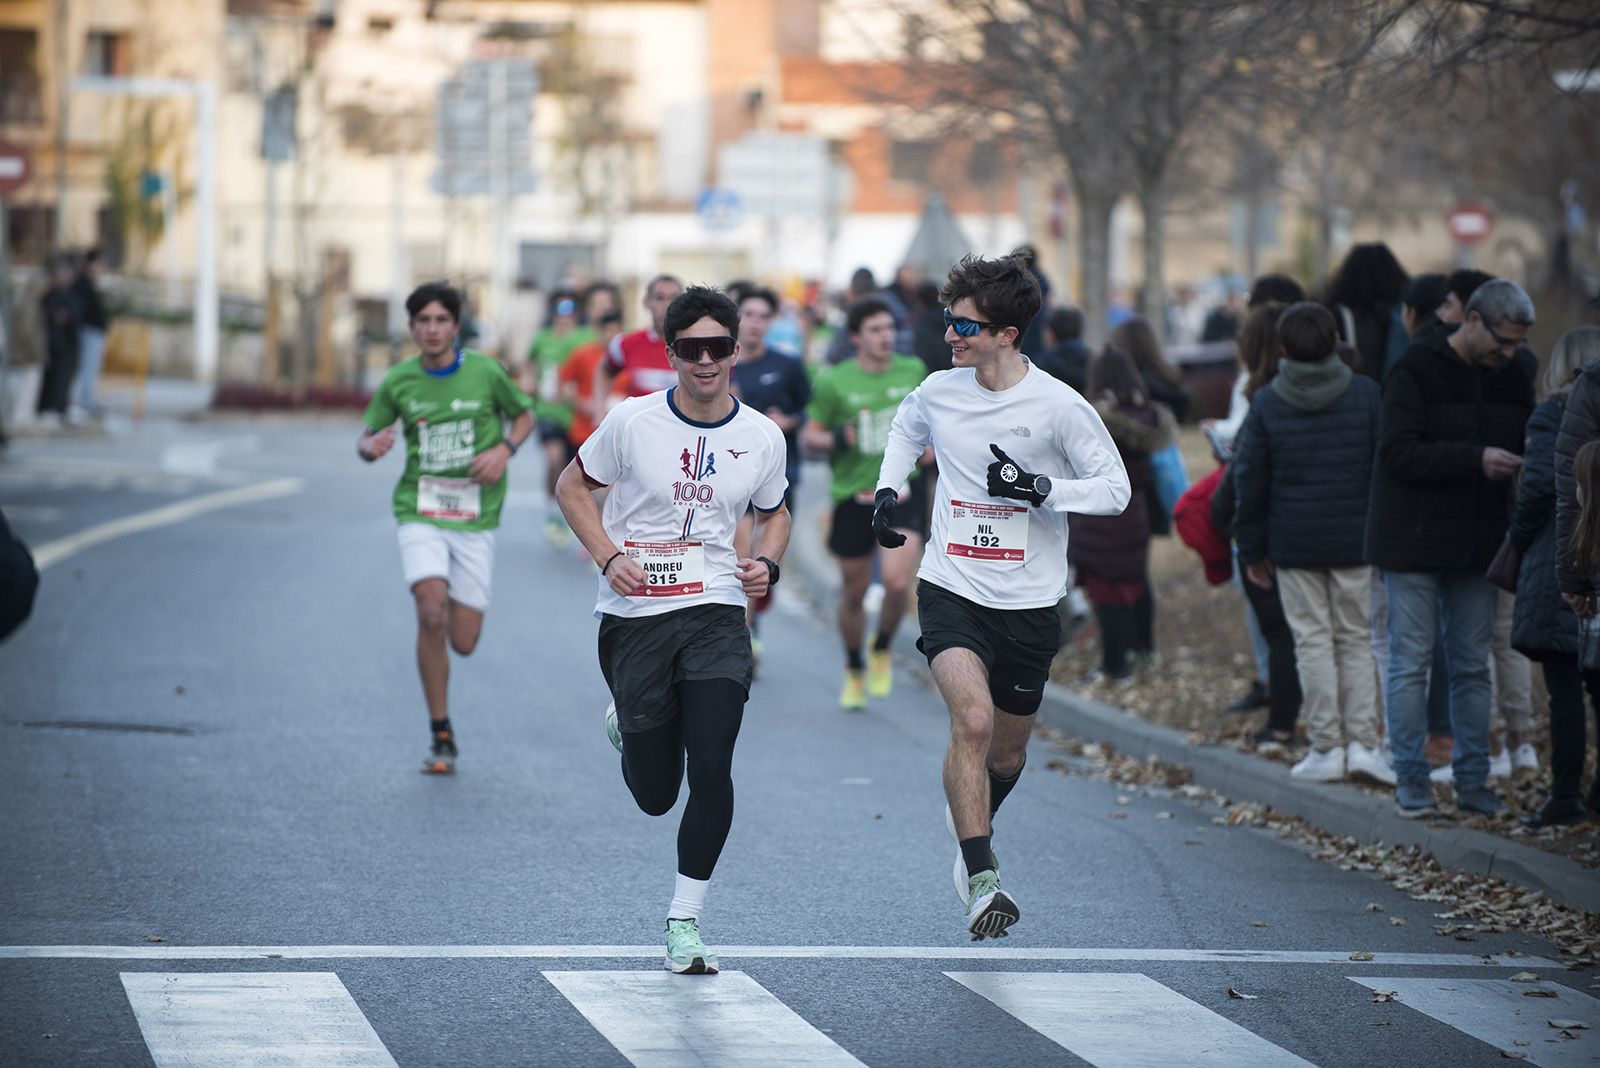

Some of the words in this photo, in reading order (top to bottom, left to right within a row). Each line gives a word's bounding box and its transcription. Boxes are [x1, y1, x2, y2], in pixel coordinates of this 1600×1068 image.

[672, 481, 713, 502] 100
[978, 524, 993, 534] NIL
[972, 535, 1000, 547] 192
[644, 562, 682, 572] ANDREU
[649, 574, 677, 584] 315
